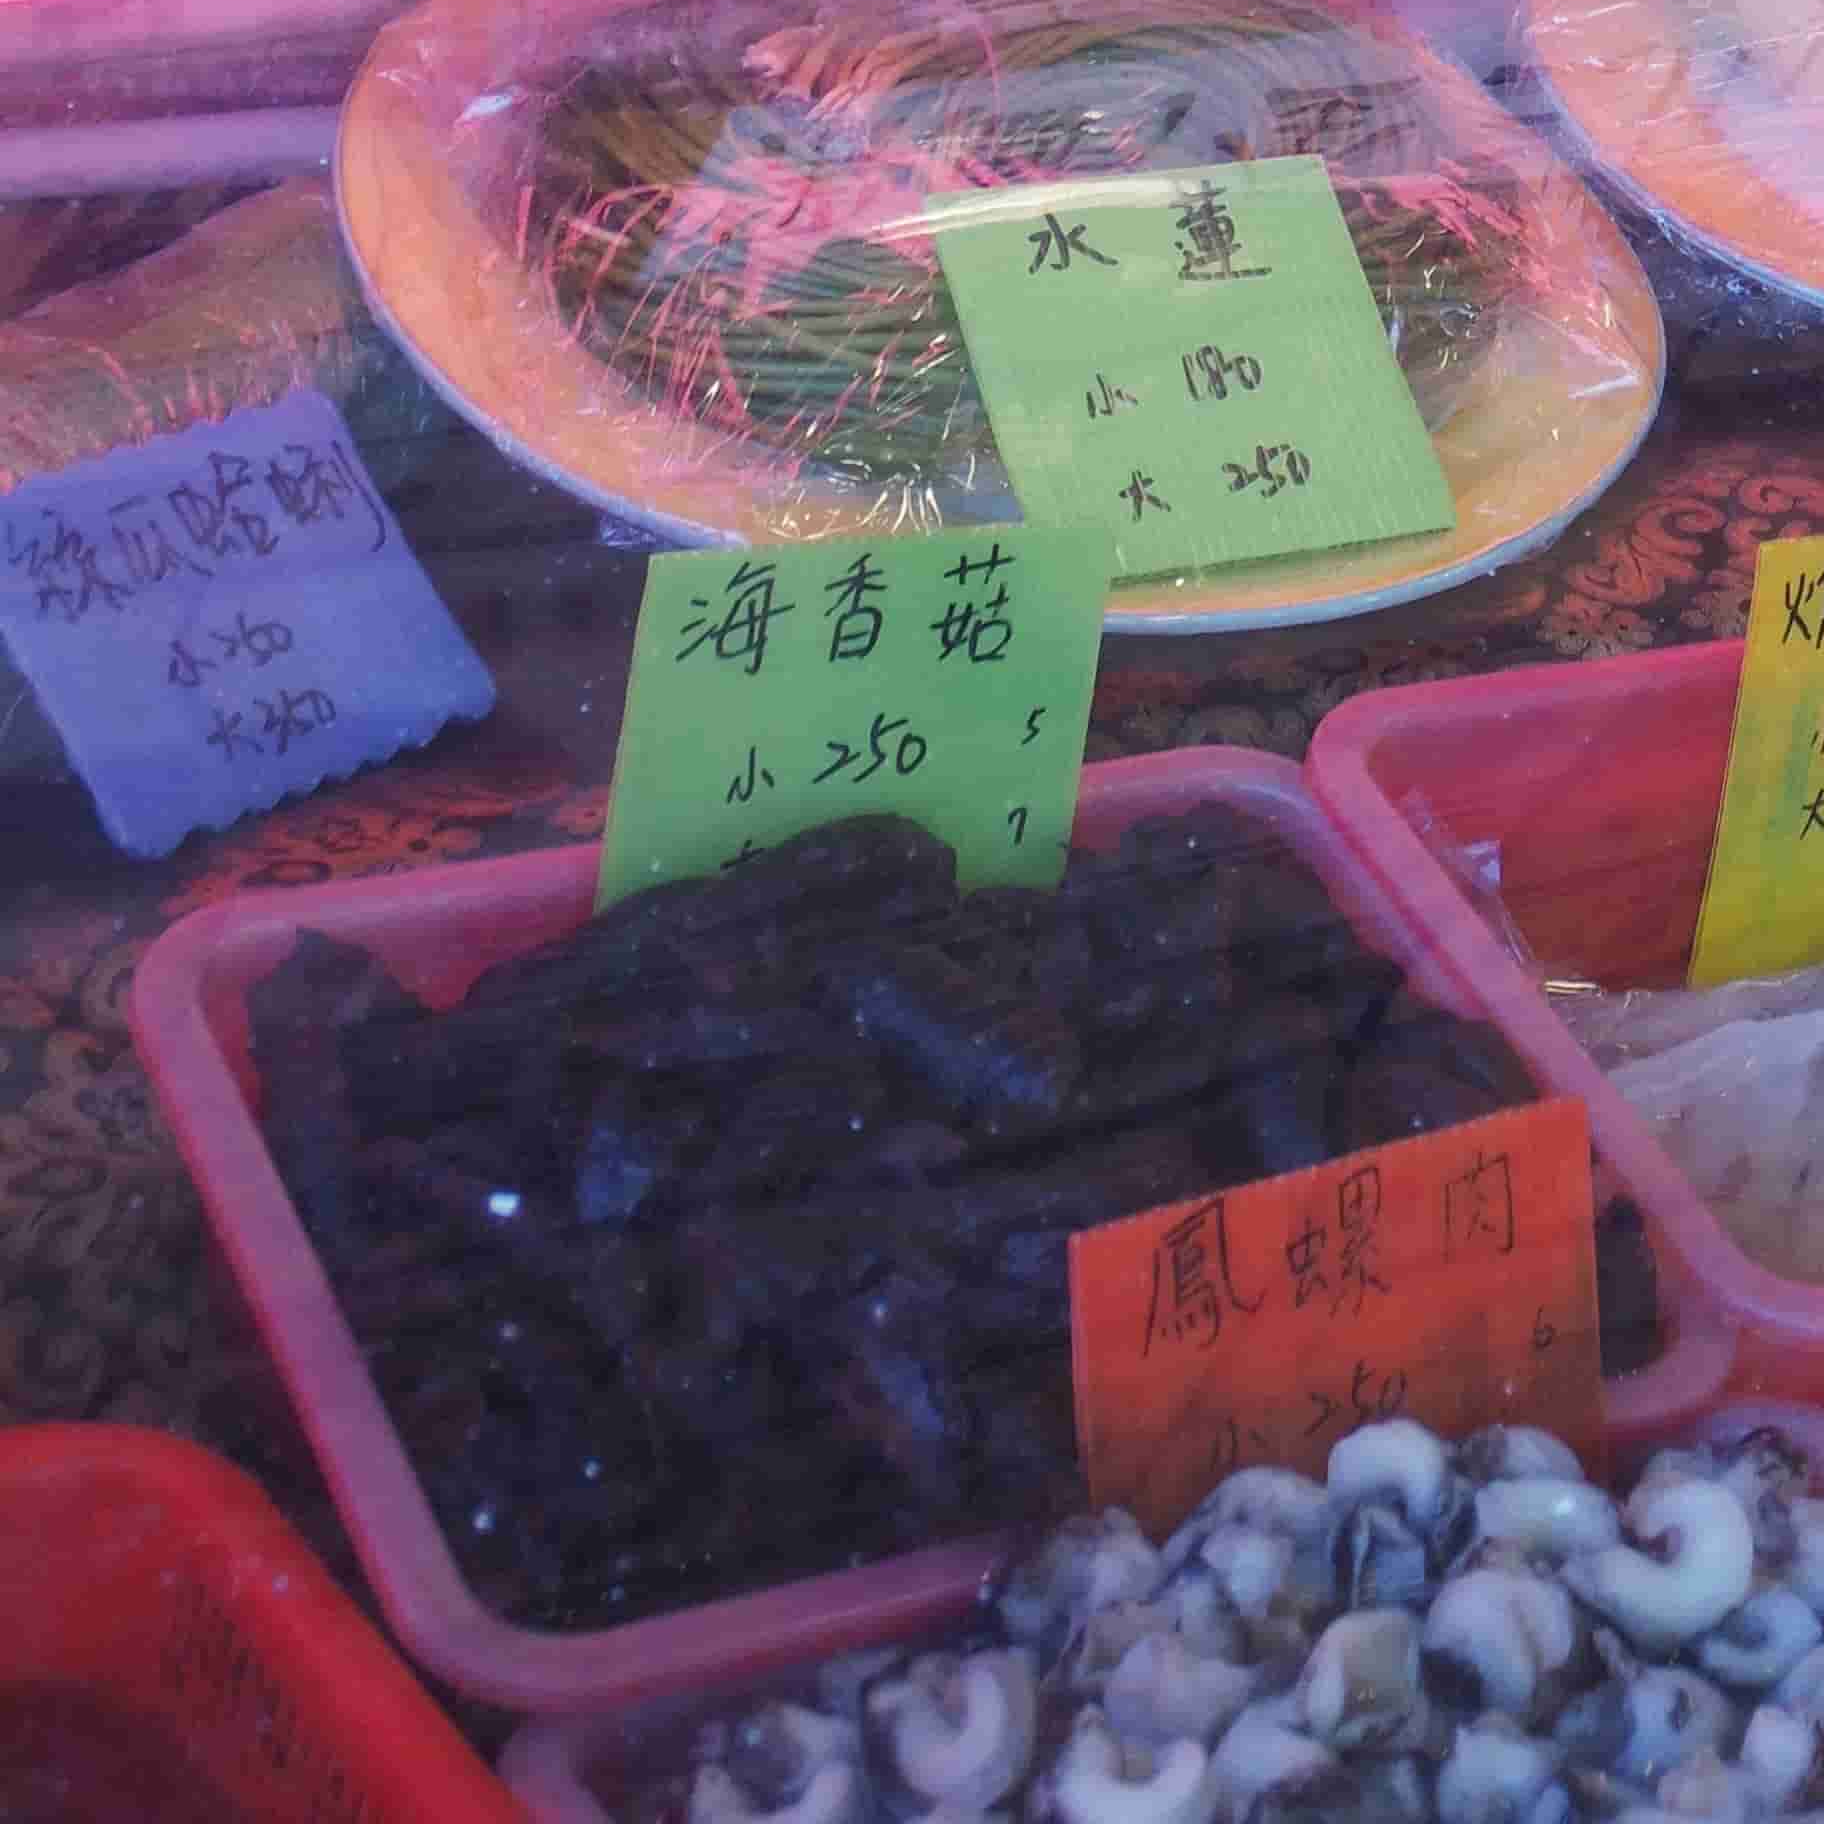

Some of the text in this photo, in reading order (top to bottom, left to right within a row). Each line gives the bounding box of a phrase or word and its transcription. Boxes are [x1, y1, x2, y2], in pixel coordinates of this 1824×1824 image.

[1027, 179, 1273, 282] 水蓮
[1086, 343, 1263, 418] 小 180
[1117, 443, 1311, 521] 大 250
[676, 543, 1016, 675] 海香菇
[726, 745, 776, 804] 小
[812, 712, 928, 784] 250
[1142, 1150, 1515, 1359] 鳳螺肉
